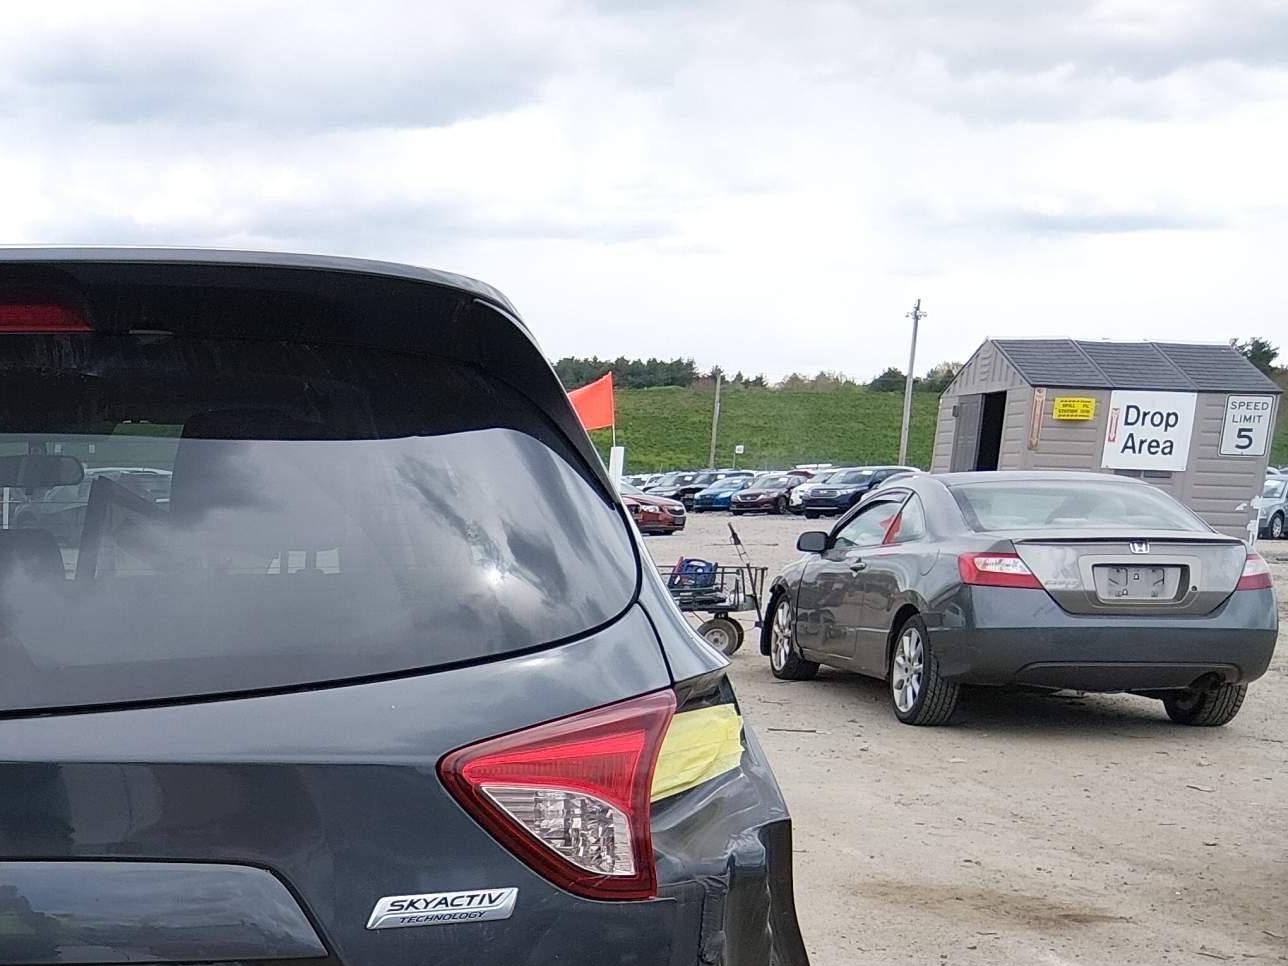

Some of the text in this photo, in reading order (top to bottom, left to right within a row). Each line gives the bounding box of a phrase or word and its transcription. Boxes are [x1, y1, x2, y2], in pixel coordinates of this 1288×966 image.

[1230, 401, 1269, 411] SPEED
[1123, 404, 1179, 432] Drop
[1232, 414, 1264, 424] LIMIT
[1120, 432, 1174, 456] Area
[1235, 428, 1254, 450] 5
[387, 892, 505, 911] SKYACTIV
[399, 911, 487, 924] TECHNOLOGY
